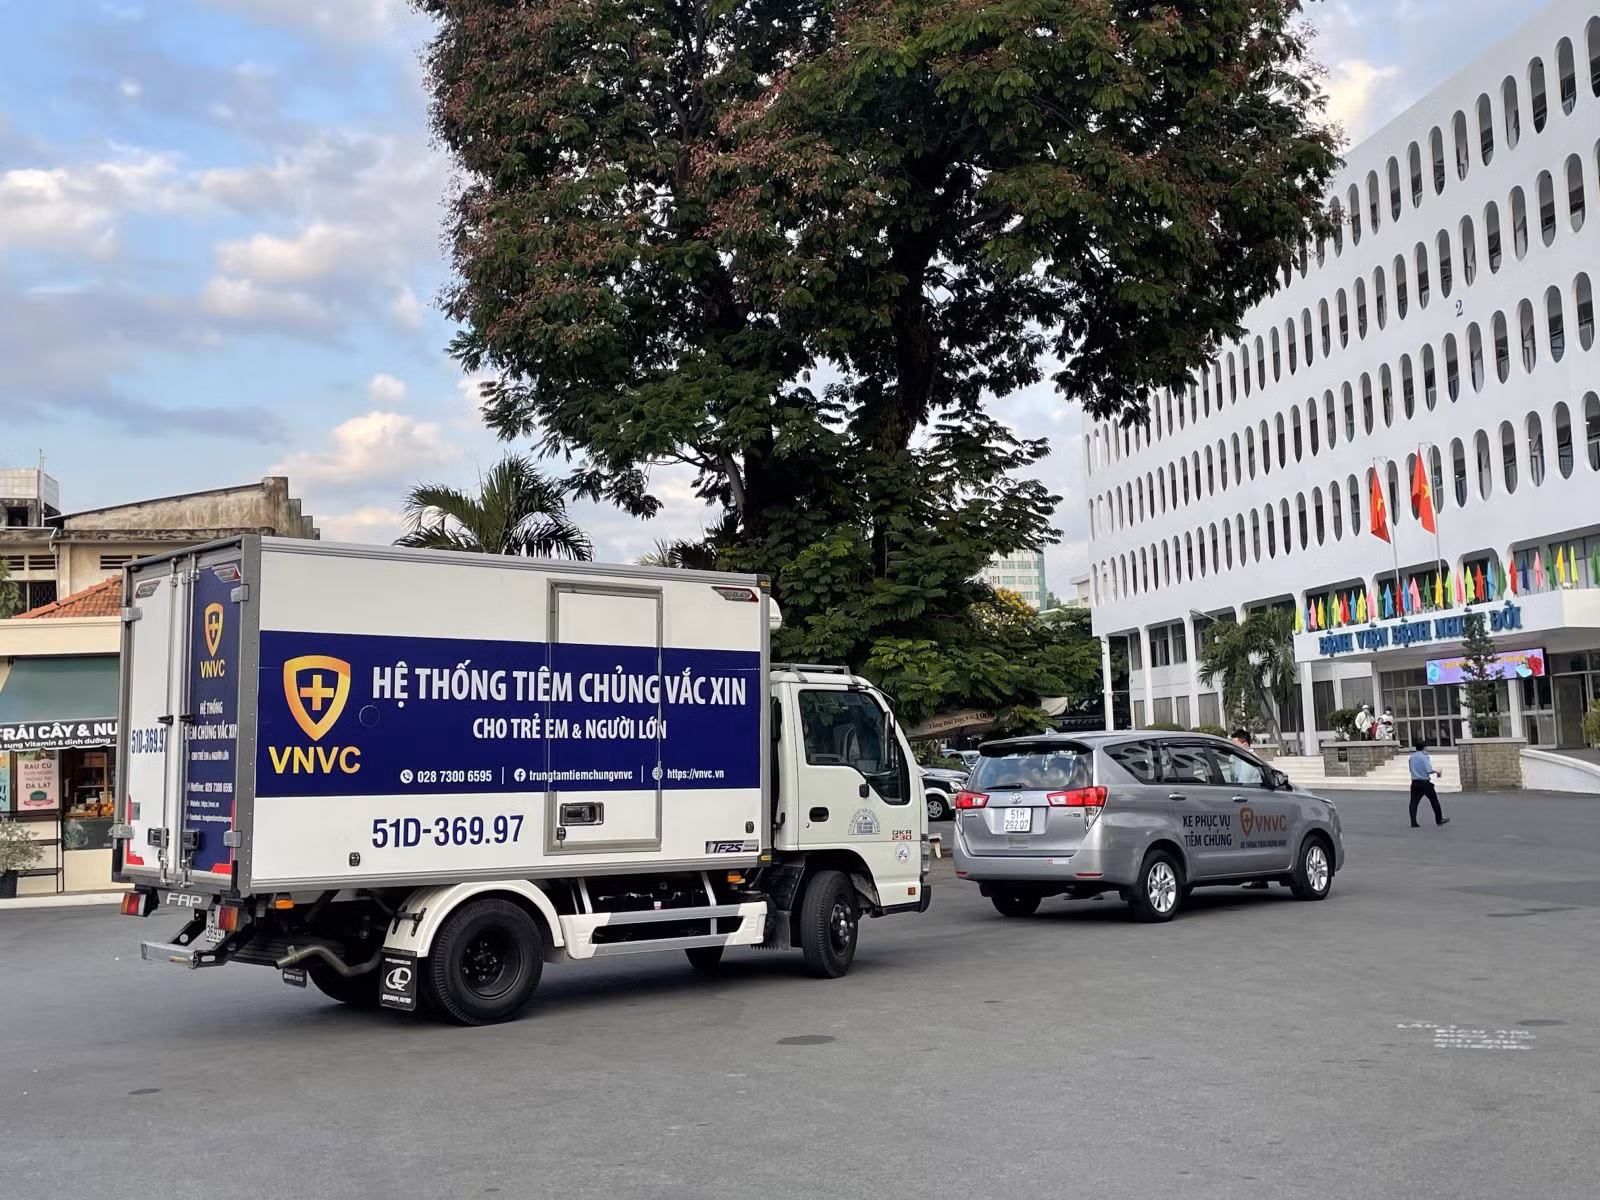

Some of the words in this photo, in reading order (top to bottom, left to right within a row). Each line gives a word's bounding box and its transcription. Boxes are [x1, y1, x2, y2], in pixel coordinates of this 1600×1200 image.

[1456, 299, 1463, 317] 2
[200, 659, 225, 678] VNVC
[373, 661, 408, 708] HỆ
[415, 660, 507, 701] THỐNG
[512, 665, 573, 702] TIÊM
[578, 664, 660, 704] CHỦNG
[664, 667, 707, 705] VẮC
[710, 677, 746, 706] XIN
[0, 724, 34, 741] RÁI
[38, 722, 74, 739] CÂY
[77, 724, 91, 737] &
[472, 718, 507, 739] CHO
[510, 713, 541, 739] TRẺ
[545, 719, 568, 739] EM
[572, 723, 582, 739] &
[585, 715, 635, 739] NGƯỜI
[639, 716, 667, 739] LỚN
[268, 746, 361, 774] VNVC
[417, 770, 437, 783] 028
[440, 770, 465, 783] 7300
[467, 769, 492, 782] 6595
[529, 769, 633, 783] trungtamtiemchungvnvc
[667, 768, 724, 780] https://vnvc.vn
[1011, 810, 1025, 819] 51H
[1183, 815, 1192, 828] XE
[1195, 815, 1218, 831] PHỤC
[1219, 814, 1231, 830] VỤ
[1255, 814, 1287, 832] VNVC
[372, 814, 524, 848] 51D-369.97
[1184, 830, 1201, 847] TIÊM
[1203, 829, 1232, 847] CHỦNG
[166, 892, 202, 907] FAP
